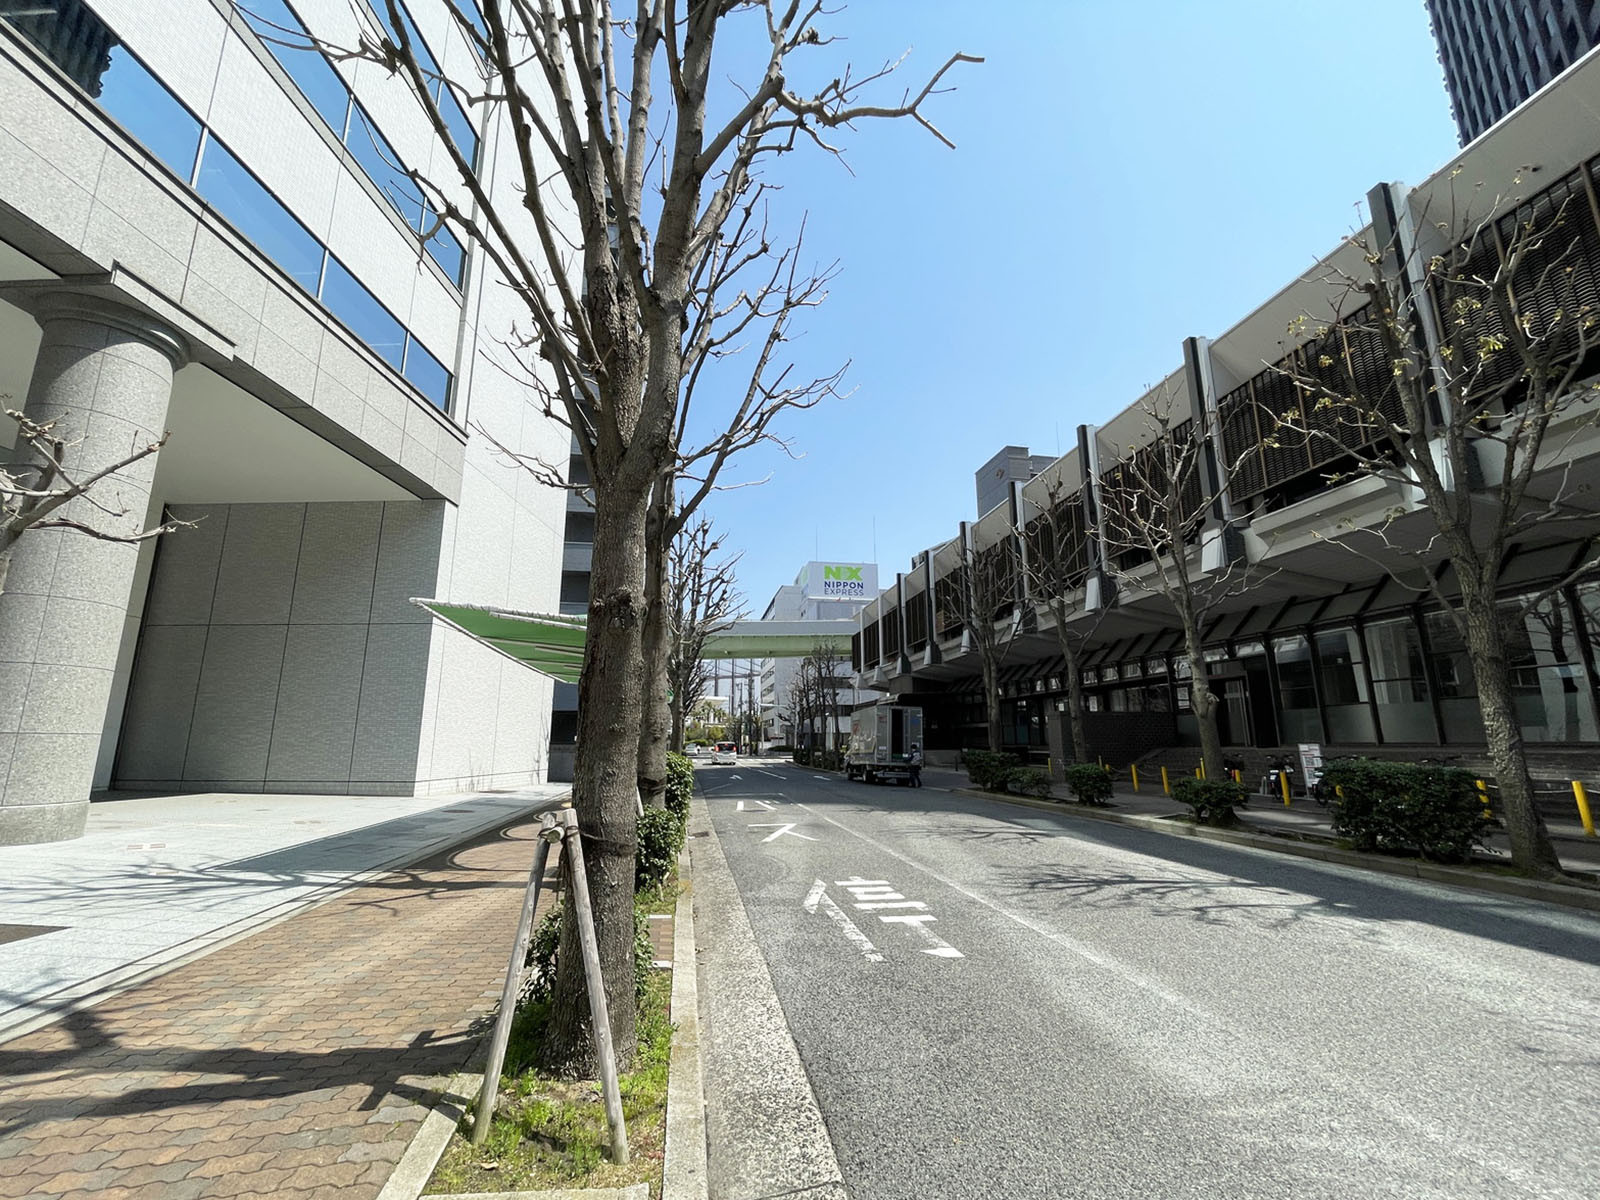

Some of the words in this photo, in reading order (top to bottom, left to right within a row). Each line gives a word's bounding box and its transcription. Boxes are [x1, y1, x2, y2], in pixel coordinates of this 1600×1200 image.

[824, 566, 863, 581] NX
[824, 581, 864, 589] NIPPON
[824, 588, 864, 596] EXPRESS
